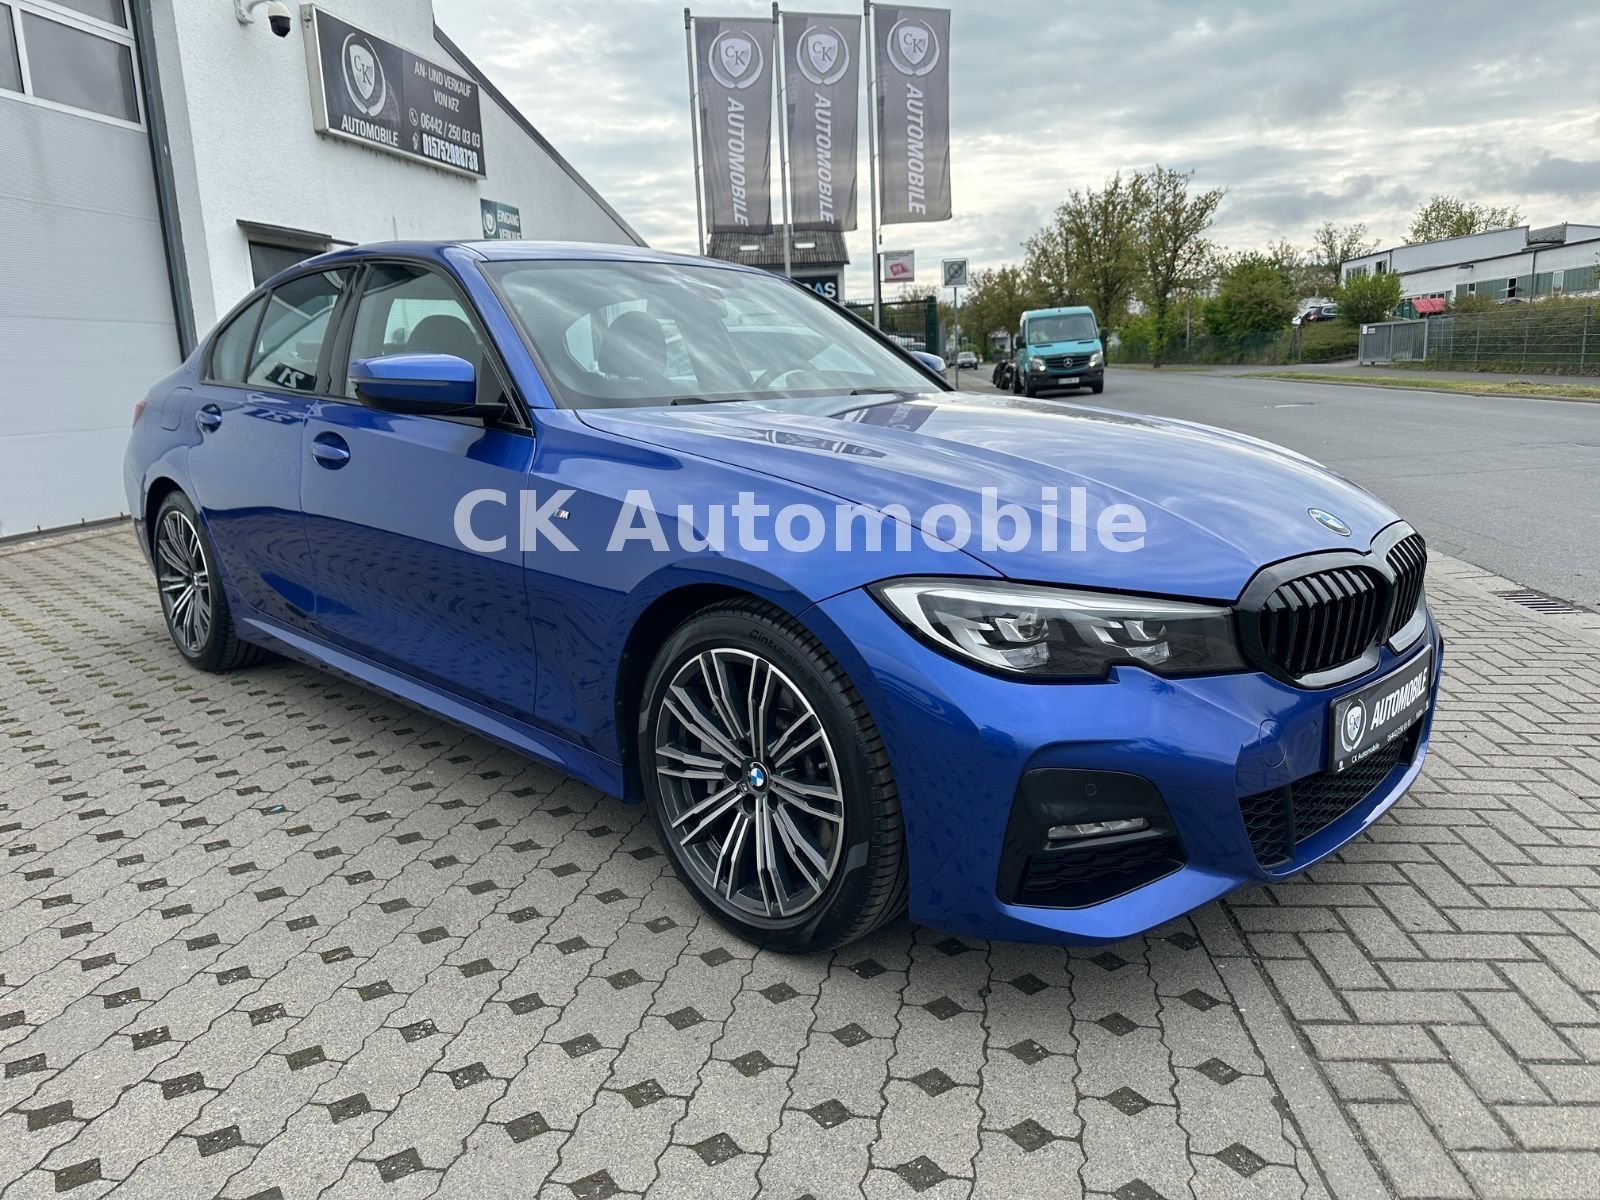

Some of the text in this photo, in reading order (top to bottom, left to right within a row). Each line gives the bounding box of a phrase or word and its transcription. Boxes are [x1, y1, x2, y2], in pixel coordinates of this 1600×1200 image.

[725, 45, 746, 66] CK
[812, 41, 833, 62] CK
[903, 33, 924, 53] CK
[354, 55, 372, 86] CK
[414, 61, 472, 99] AN- UND VERKAUF
[433, 89, 460, 113] VON KFZ
[341, 113, 399, 147] AUTOMOBILE
[420, 112, 443, 136] 06442
[448, 123, 461, 142] 250
[462, 129, 471, 145] 03
[472, 132, 481, 148] 03
[727, 96, 749, 227] AUTOMOBILE
[815, 92, 834, 224] AUTOMOBILE
[906, 83, 926, 215] AUTOMOBILE
[804, 282, 836, 299] AS
[1370, 667, 1428, 731] AUTOMOBILE
